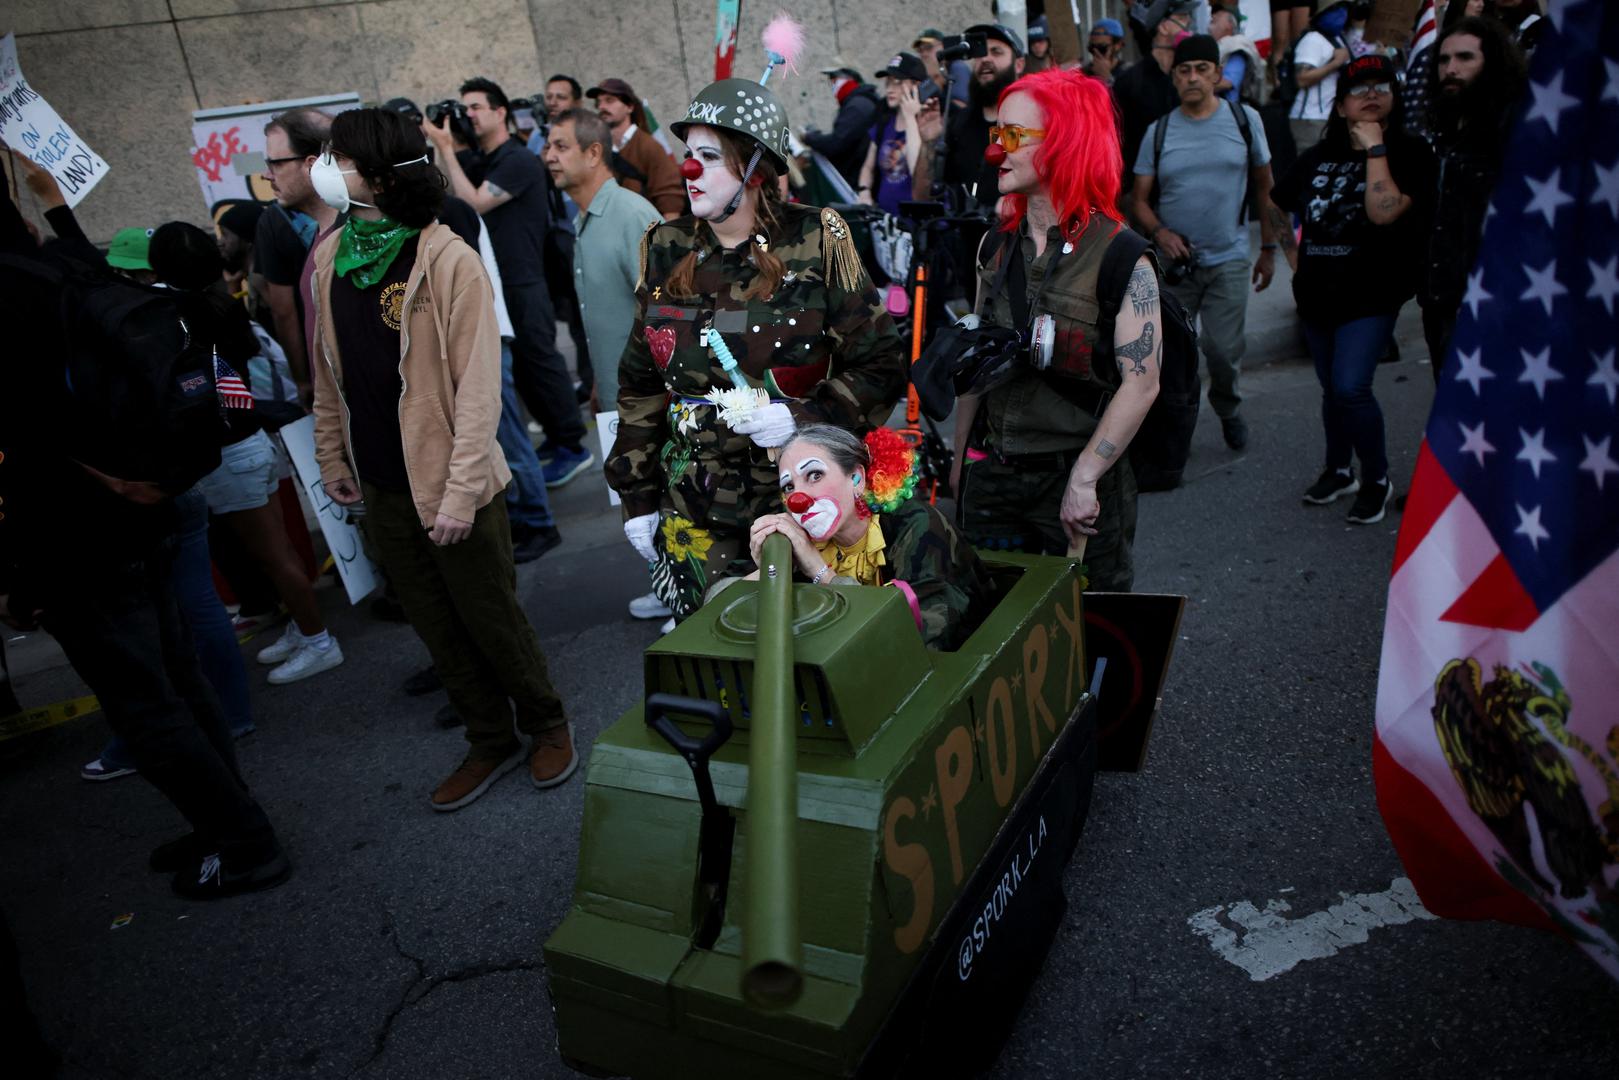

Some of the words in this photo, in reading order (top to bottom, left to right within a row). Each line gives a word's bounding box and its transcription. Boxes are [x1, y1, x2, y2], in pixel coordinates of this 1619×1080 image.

[0, 80, 39, 134] migrants
[21, 123, 41, 149] ON
[28, 124, 71, 169] TOLEN
[56, 144, 101, 195] LAND!
[958, 815, 1048, 981] @SPORK_LA
